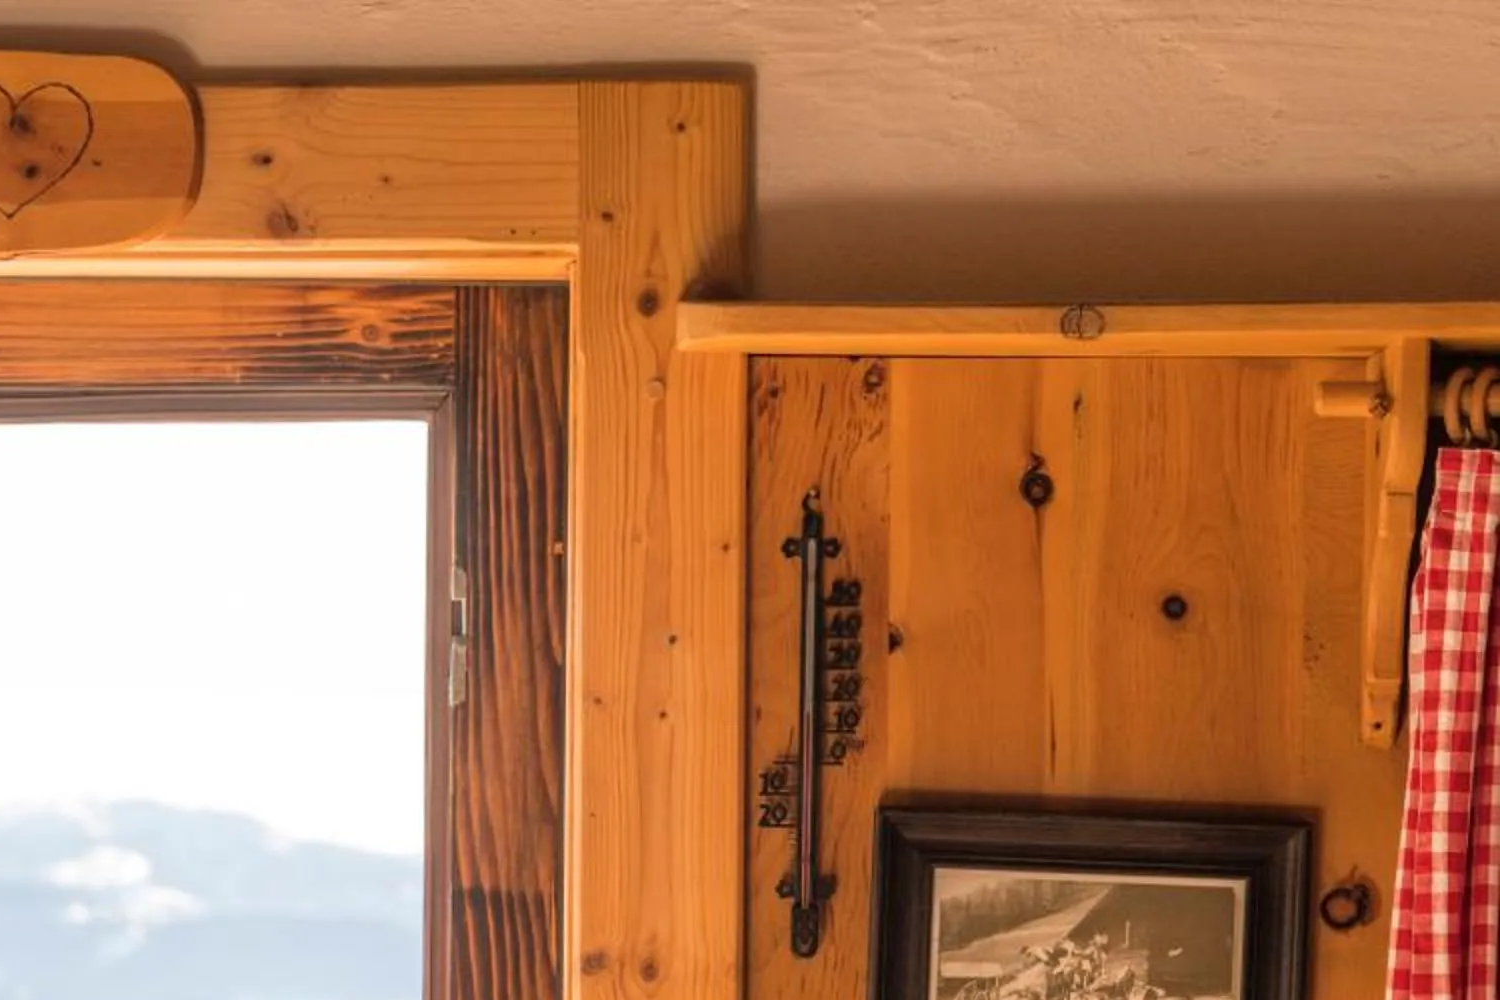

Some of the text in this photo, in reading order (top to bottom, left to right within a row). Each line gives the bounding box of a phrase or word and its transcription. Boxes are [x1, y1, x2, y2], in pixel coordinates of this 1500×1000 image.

[834, 706, 861, 731] 10
[831, 743, 847, 760] 0
[758, 770, 788, 793] 10
[758, 802, 788, 826] 20
